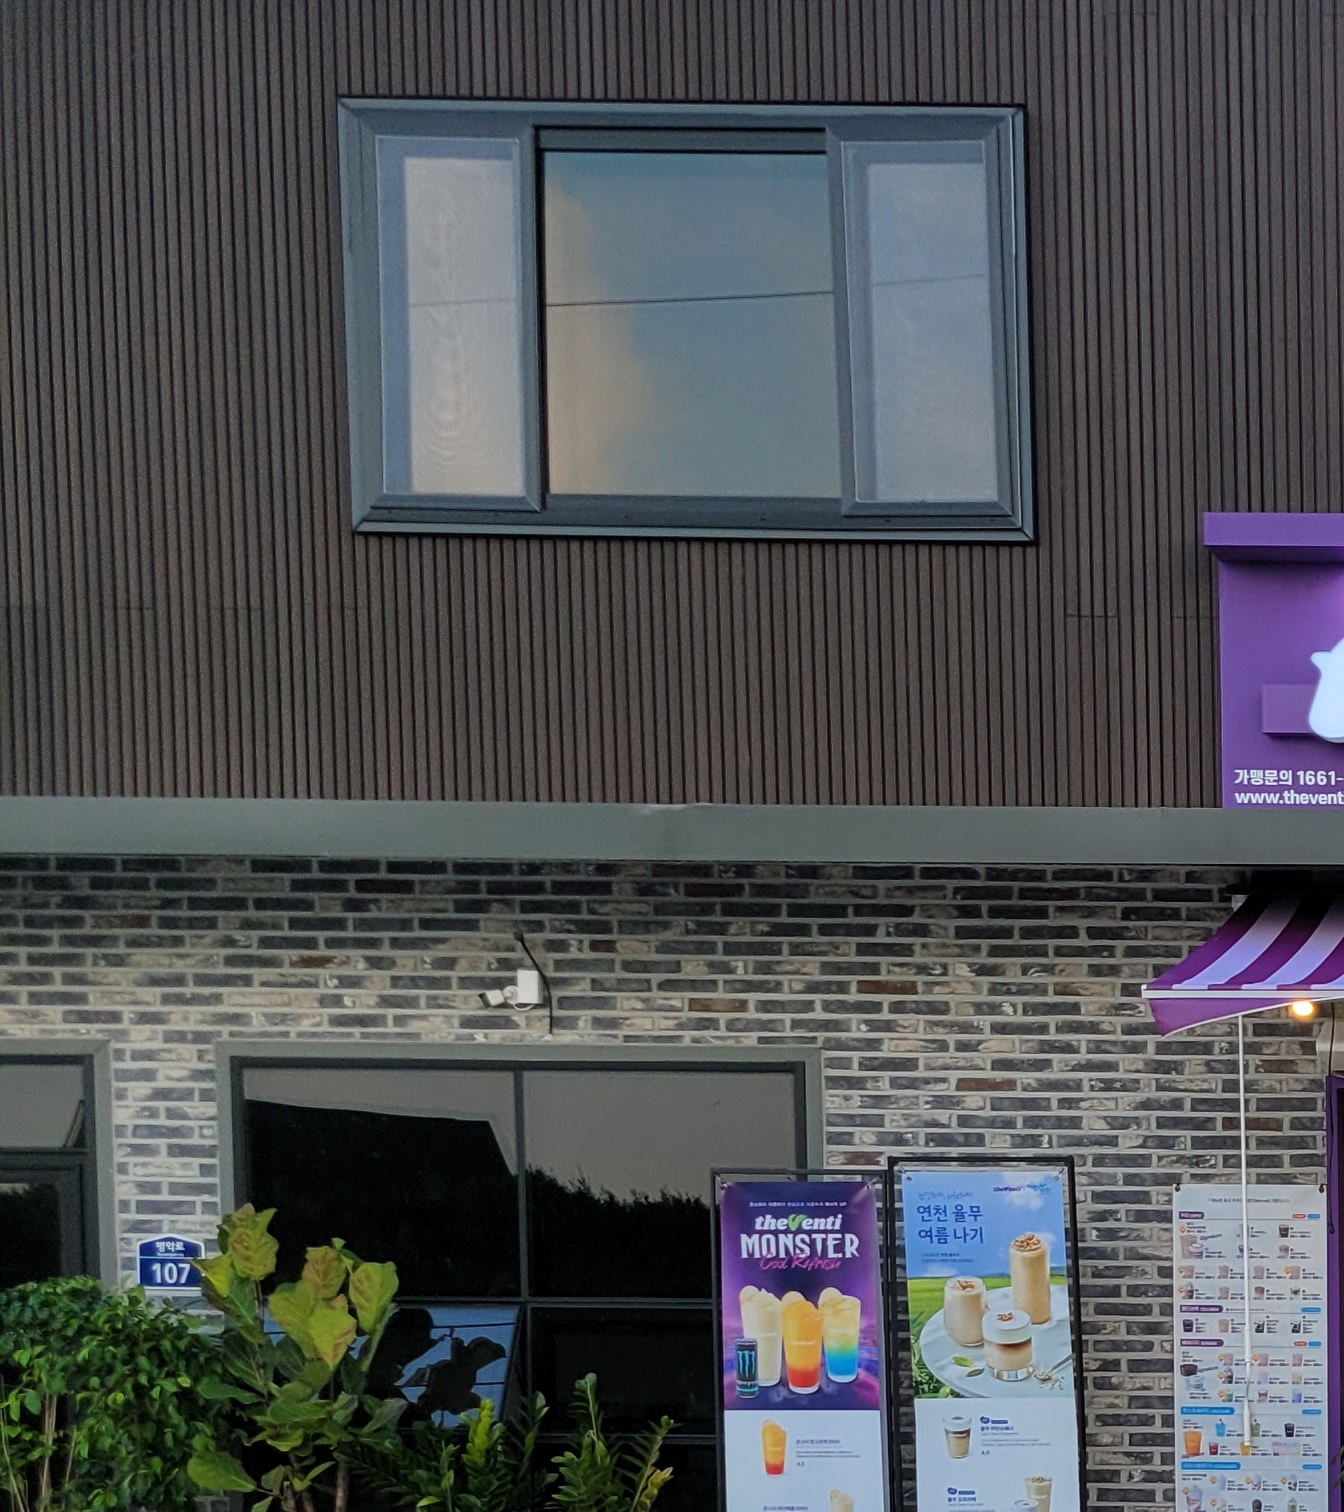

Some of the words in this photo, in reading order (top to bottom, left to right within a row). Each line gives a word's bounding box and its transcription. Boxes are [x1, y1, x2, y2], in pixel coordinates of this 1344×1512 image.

[1233, 769, 1293, 786] 가맹문의
[754, 1213, 843, 1231] theVenti
[916, 1203, 948, 1223] 연천
[951, 1203, 984, 1223] 율무
[918, 1226, 950, 1245] 여름
[953, 1226, 985, 1245] 나기
[740, 1233, 860, 1259] MONSTER
[151, 1262, 191, 1284] 107
